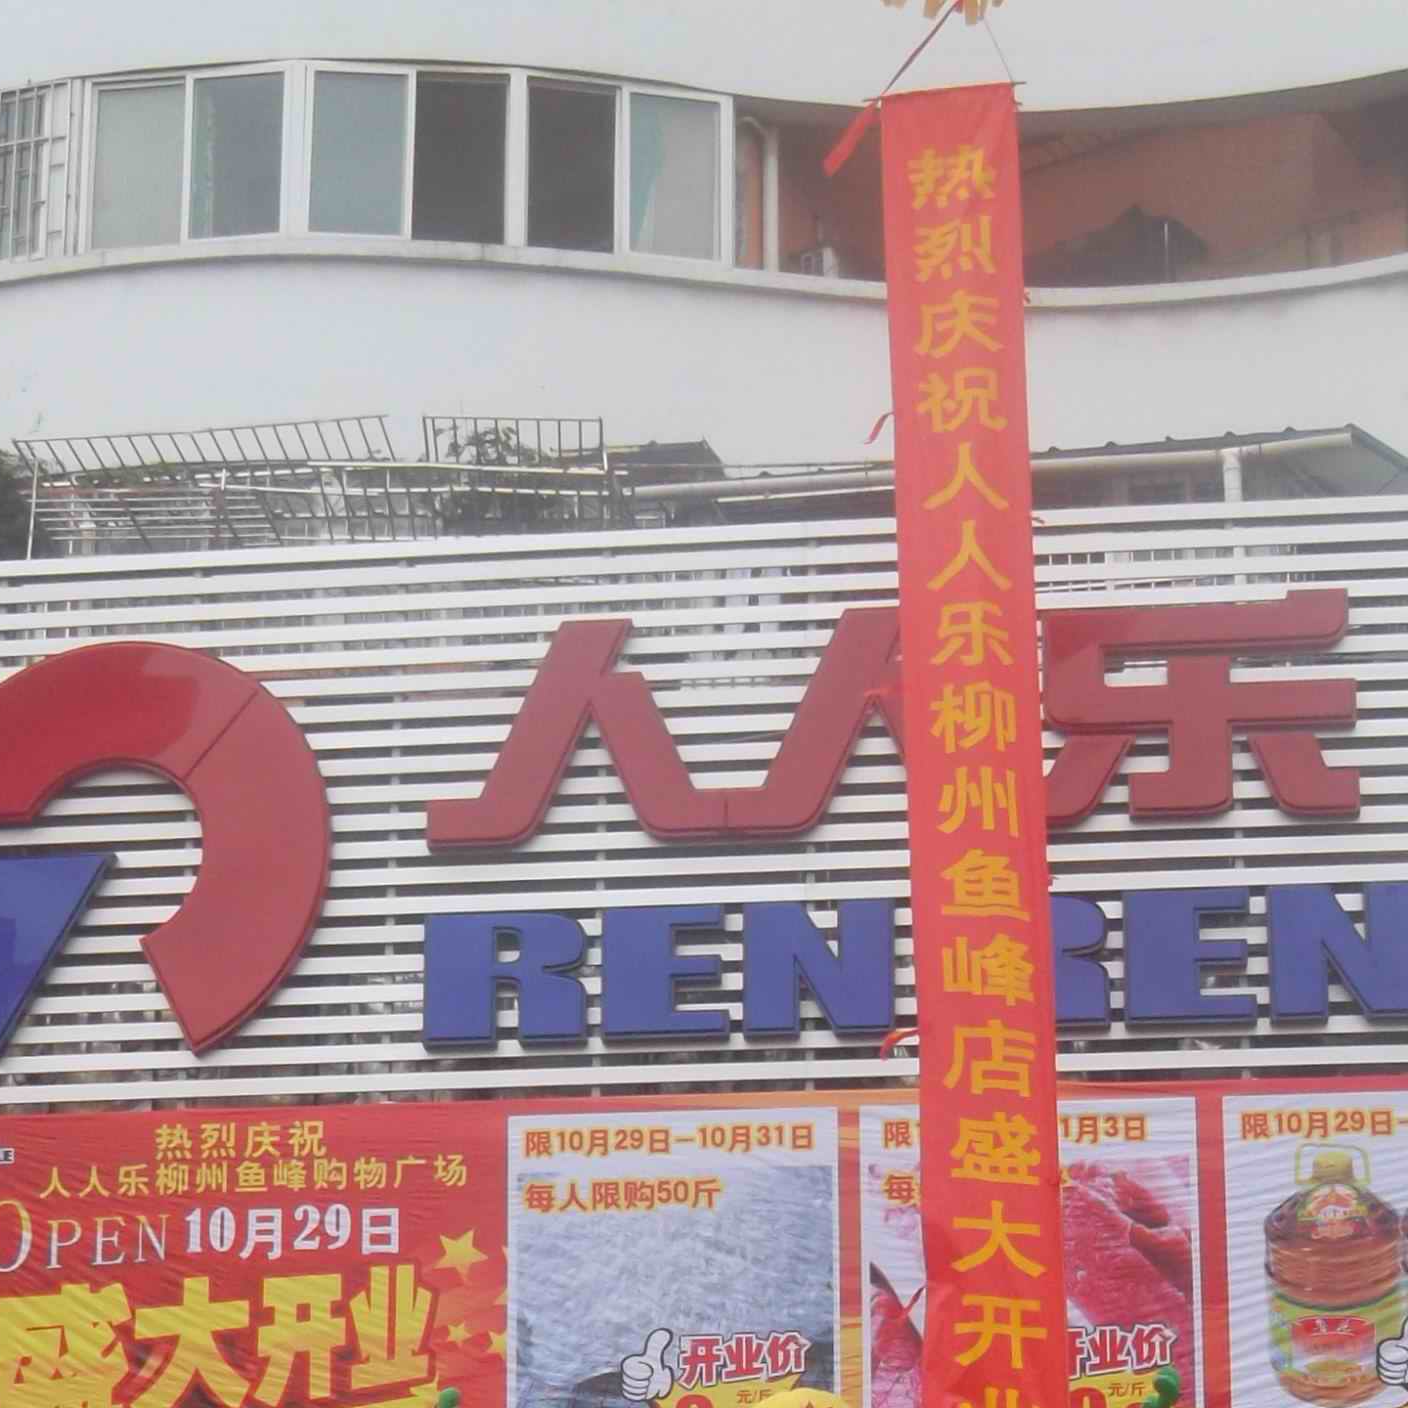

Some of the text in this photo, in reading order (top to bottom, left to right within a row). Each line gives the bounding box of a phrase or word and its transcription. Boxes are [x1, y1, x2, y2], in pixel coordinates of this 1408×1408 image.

[422, 896, 898, 1050] REN
[154, 1119, 328, 1163] 热烈庆祝
[39, 1152, 469, 1200] 人人乐柳州鱼峰购物广场
[525, 1176, 722, 1213] 每人限购50斤
[184, 1203, 402, 1262] 10月29日
[678, 1331, 812, 1389] 开业价
